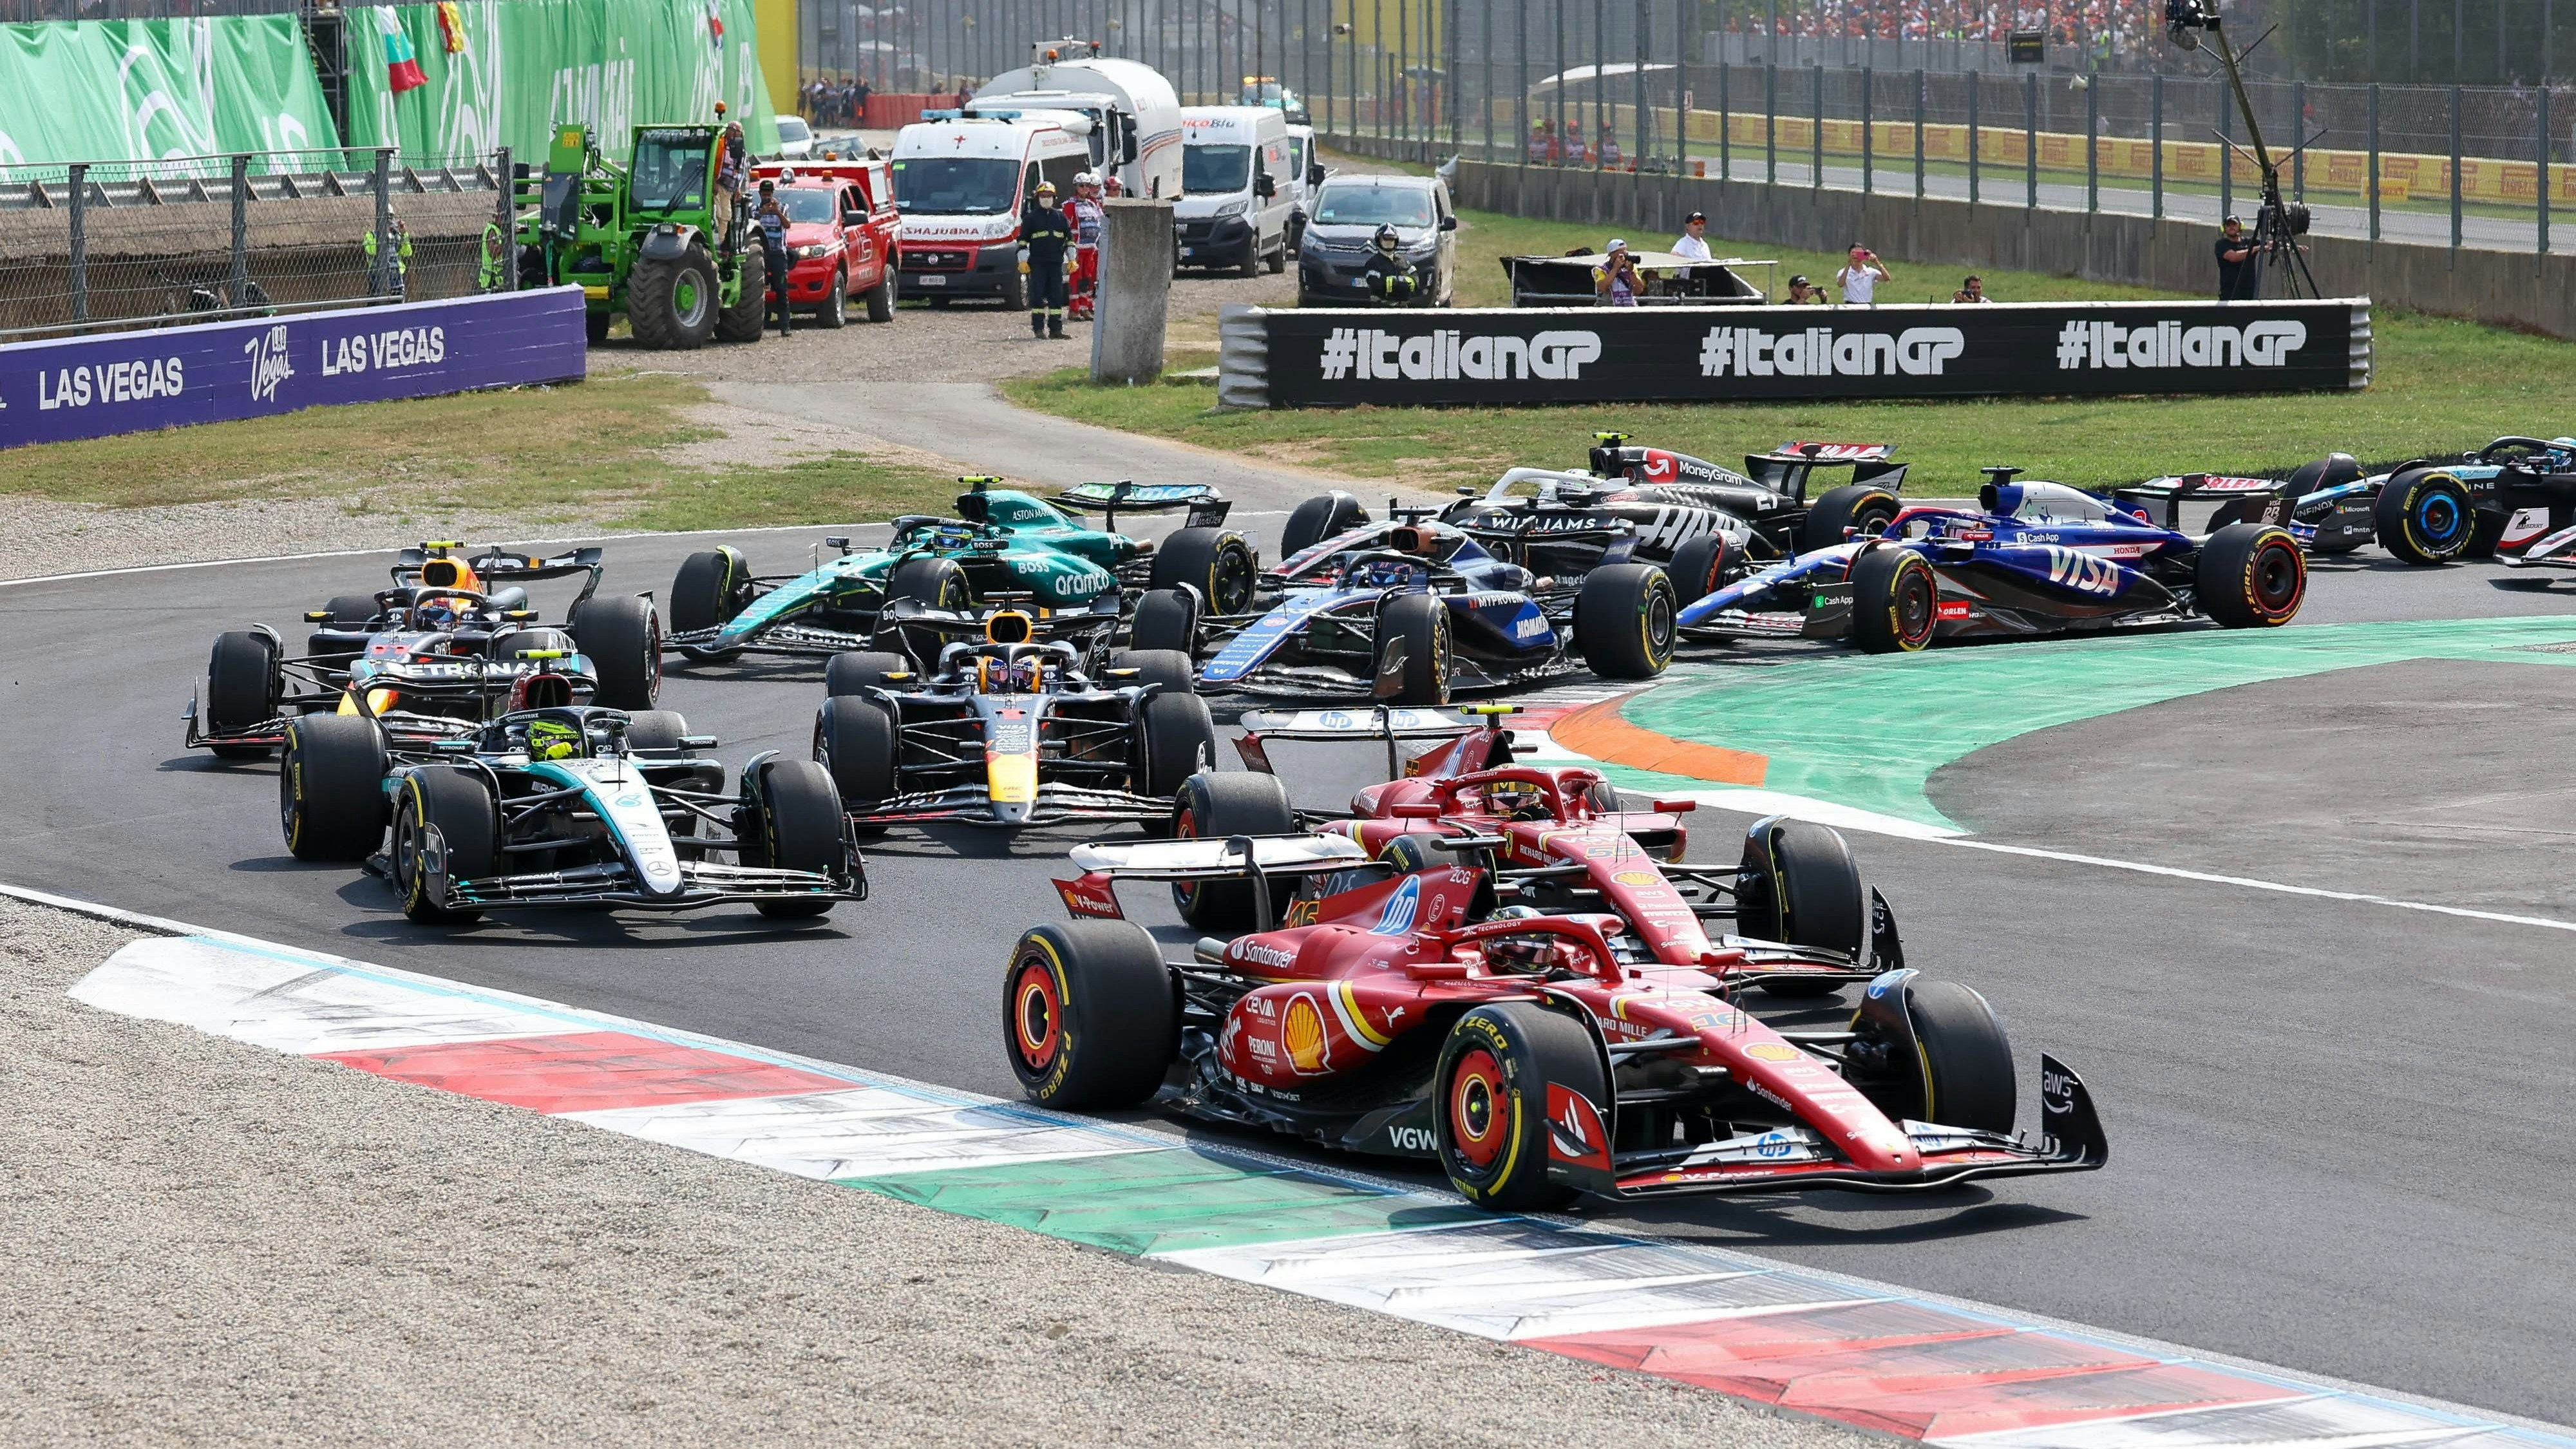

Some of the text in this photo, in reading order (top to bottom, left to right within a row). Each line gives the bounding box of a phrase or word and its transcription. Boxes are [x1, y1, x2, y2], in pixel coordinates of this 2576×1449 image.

[322, 327, 444, 377] LAS VEGAS
[1321, 327, 1601, 380] #ItalianGP
[1700, 325, 1964, 377] #ItalianGP
[2058, 319, 2307, 369] #ItalianGP
[245, 331, 294, 402] Vegas
[39, 357, 184, 410] LAS VEGAS
[1680, 460, 1742, 485] MoneyGram
[1083, 484, 1207, 502] armco
[1012, 509, 1033, 520] ASTON
[2297, 499, 2334, 517] INFINOX
[1492, 516, 1596, 530] WIIAMS
[1107, 533, 1124, 550] 14
[2028, 533, 2060, 542] Cash App
[1018, 562, 1050, 574] BOSS
[2047, 547, 2119, 598] VISA
[1056, 572, 1110, 596] aramco
[2244, 563, 2255, 605] ZERO
[1478, 594, 1524, 609] MYPROTEIN
[1824, 596, 1853, 606] Cash App
[883, 609, 897, 621] BO
[1944, 607, 1967, 616] ORLEN
[506, 712, 539, 721] CROWDSTRIKE
[1325, 710, 1349, 729] hp
[1394, 710, 1417, 728] hp
[1466, 772, 1499, 782] TECHNOLOGY
[426, 831, 440, 854] IWC
[1520, 844, 1542, 862] RICHARD
[1585, 846, 1641, 859] 55
[1450, 869, 1471, 885] ZCG
[404, 873, 422, 914] ZERO
[1077, 894, 1114, 913] V-Power
[1289, 901, 1320, 928] 16
[1478, 921, 1522, 932] TECHNOLOGY
[1244, 940, 1298, 969] Santander
[1256, 1018, 1276, 1026] LOGISTICS
[1619, 1021, 1647, 1036] MILLE
[1689, 1012, 1751, 1032] 16
[1465, 1016, 1508, 1050] ZERO
[1248, 1035, 1276, 1057] PERONI
[1040, 1054, 1068, 1100] ZERO
[2044, 1070, 2072, 1097] aws
[1756, 1083, 1793, 1112] Santander
[1388, 1126, 1438, 1151] VGW
[1760, 1133, 1791, 1158] hp
[1685, 1170, 1775, 1180] V-Power
